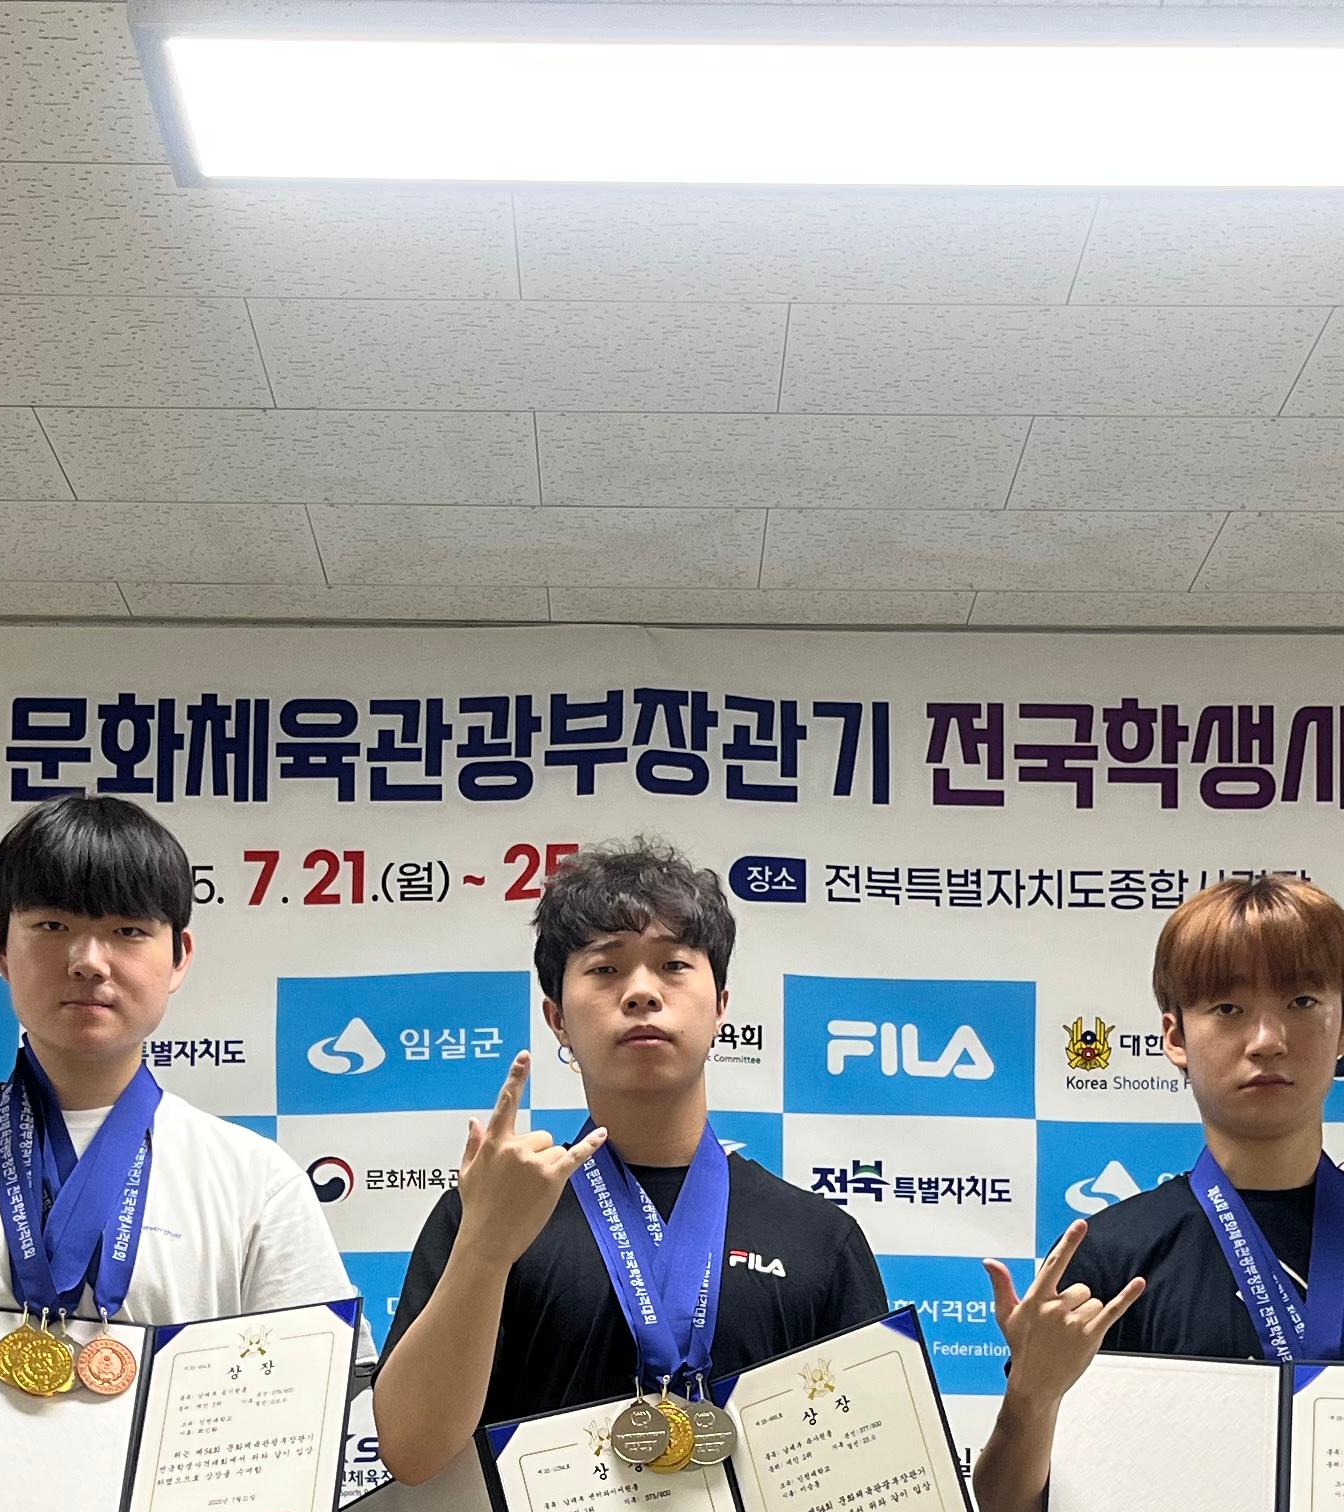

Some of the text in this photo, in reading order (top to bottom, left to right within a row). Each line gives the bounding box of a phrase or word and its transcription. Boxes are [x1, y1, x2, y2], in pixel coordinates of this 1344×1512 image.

[5, 688, 890, 806] 문화체육관광부장관기
[746, 864, 1312, 912] 장소 전북특별자치도종합
[400, 1027, 503, 1060] 임실군
[827, 1020, 994, 1080] FILA
[714, 1054, 761, 1064] Committee
[1066, 1075, 1178, 1093] Korea Shooting
[893, 1175, 1012, 1205] 특별자치도
[729, 1250, 787, 1278] FILA
[934, 1341, 1011, 1357] Federation
